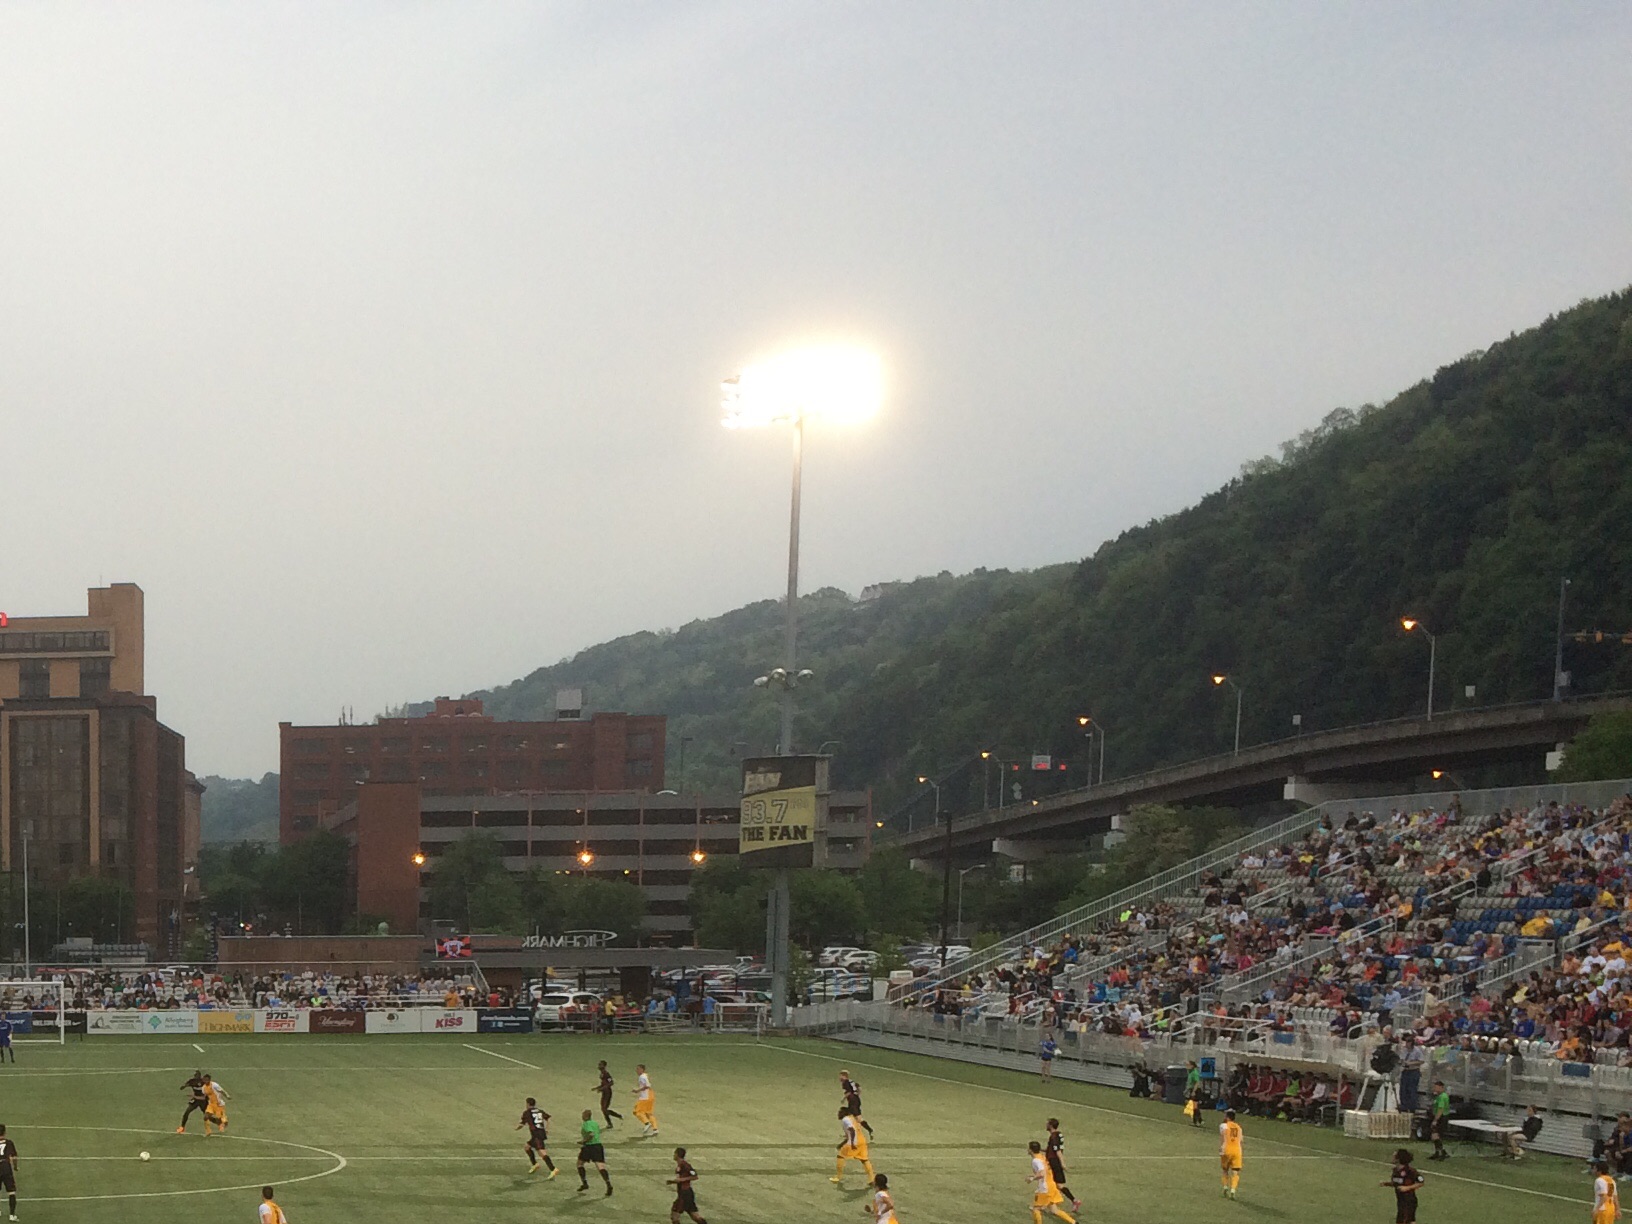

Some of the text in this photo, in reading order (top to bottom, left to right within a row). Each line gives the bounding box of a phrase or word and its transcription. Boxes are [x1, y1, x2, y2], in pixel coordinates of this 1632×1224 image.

[741, 798, 789, 824] 93.7
[741, 825, 808, 841] THE FAN
[265, 1012, 289, 1021] 970
[264, 1020, 296, 1029] ESPN
[435, 1017, 464, 1028] KISS
